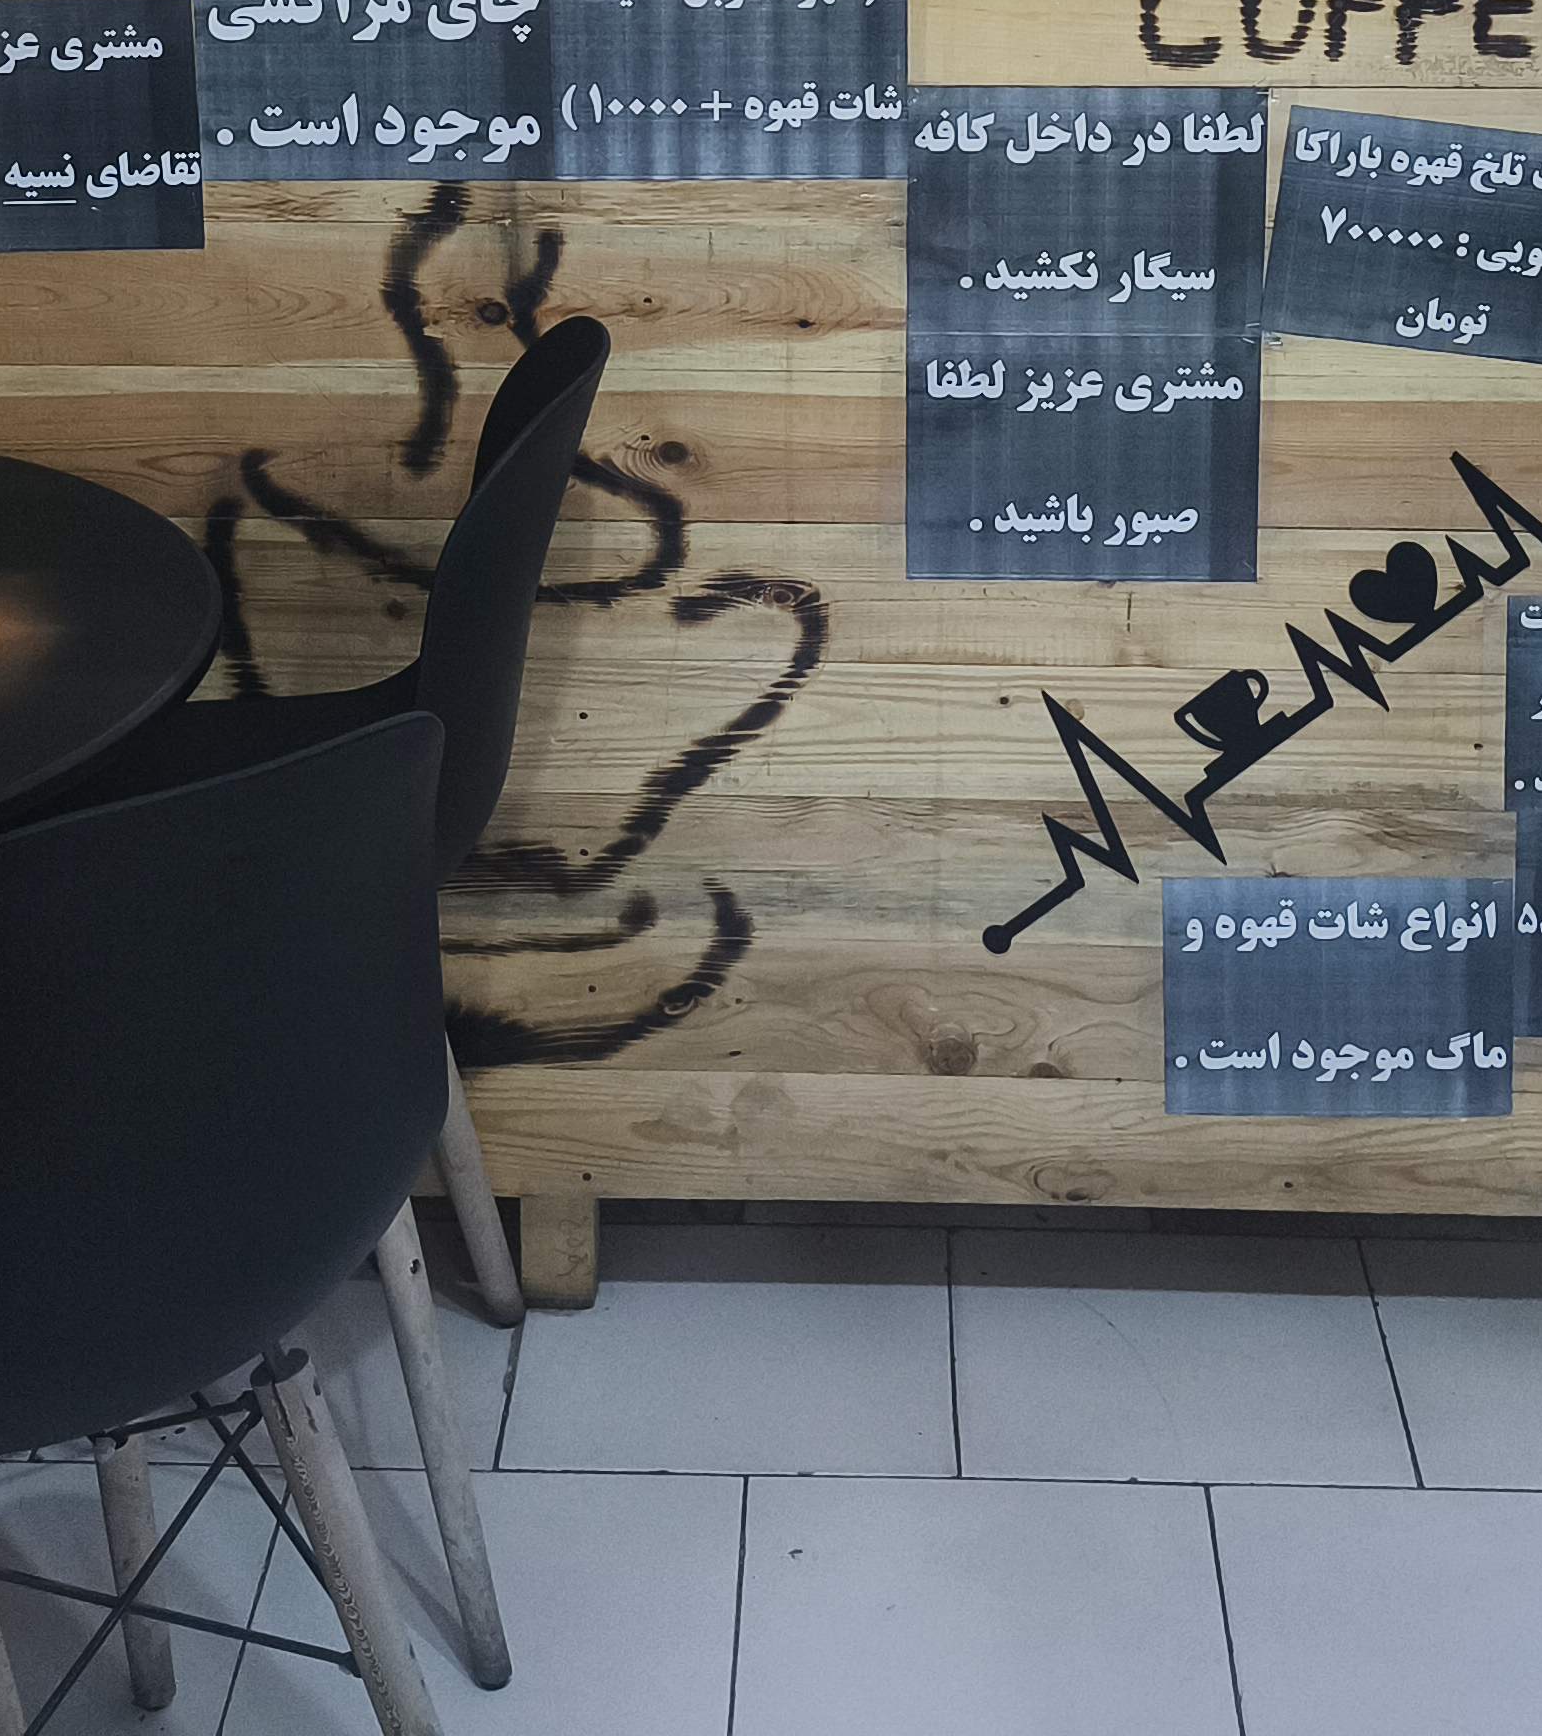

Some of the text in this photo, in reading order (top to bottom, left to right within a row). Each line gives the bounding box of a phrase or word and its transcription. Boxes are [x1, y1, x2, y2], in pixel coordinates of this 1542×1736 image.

[50, 25, 163, 72] مشتری
[743, 81, 818, 131] قهوه
[829, 82, 903, 121] شات
[250, 93, 541, 163] موجود است
[912, 112, 1265, 166] لطفا در داخل کافه
[1295, 128, 1382, 178] باراکا
[3, 156, 76, 198] نسیه
[85, 151, 202, 199] تقاضای
[1390, 142, 1462, 186] قهوه
[1468, 145, 1525, 194] تلخ
[984, 251, 1217, 304] سیگار نکشید
[1395, 300, 1489, 345] تومان
[925, 359, 1246, 415] مشتری عزیز لطفا
[991, 494, 1201, 549] صبور باشید
[1181, 898, 1497, 952] انواع شات قهوه و
[1199, 1031, 1507, 1082] ماگ موجود است
